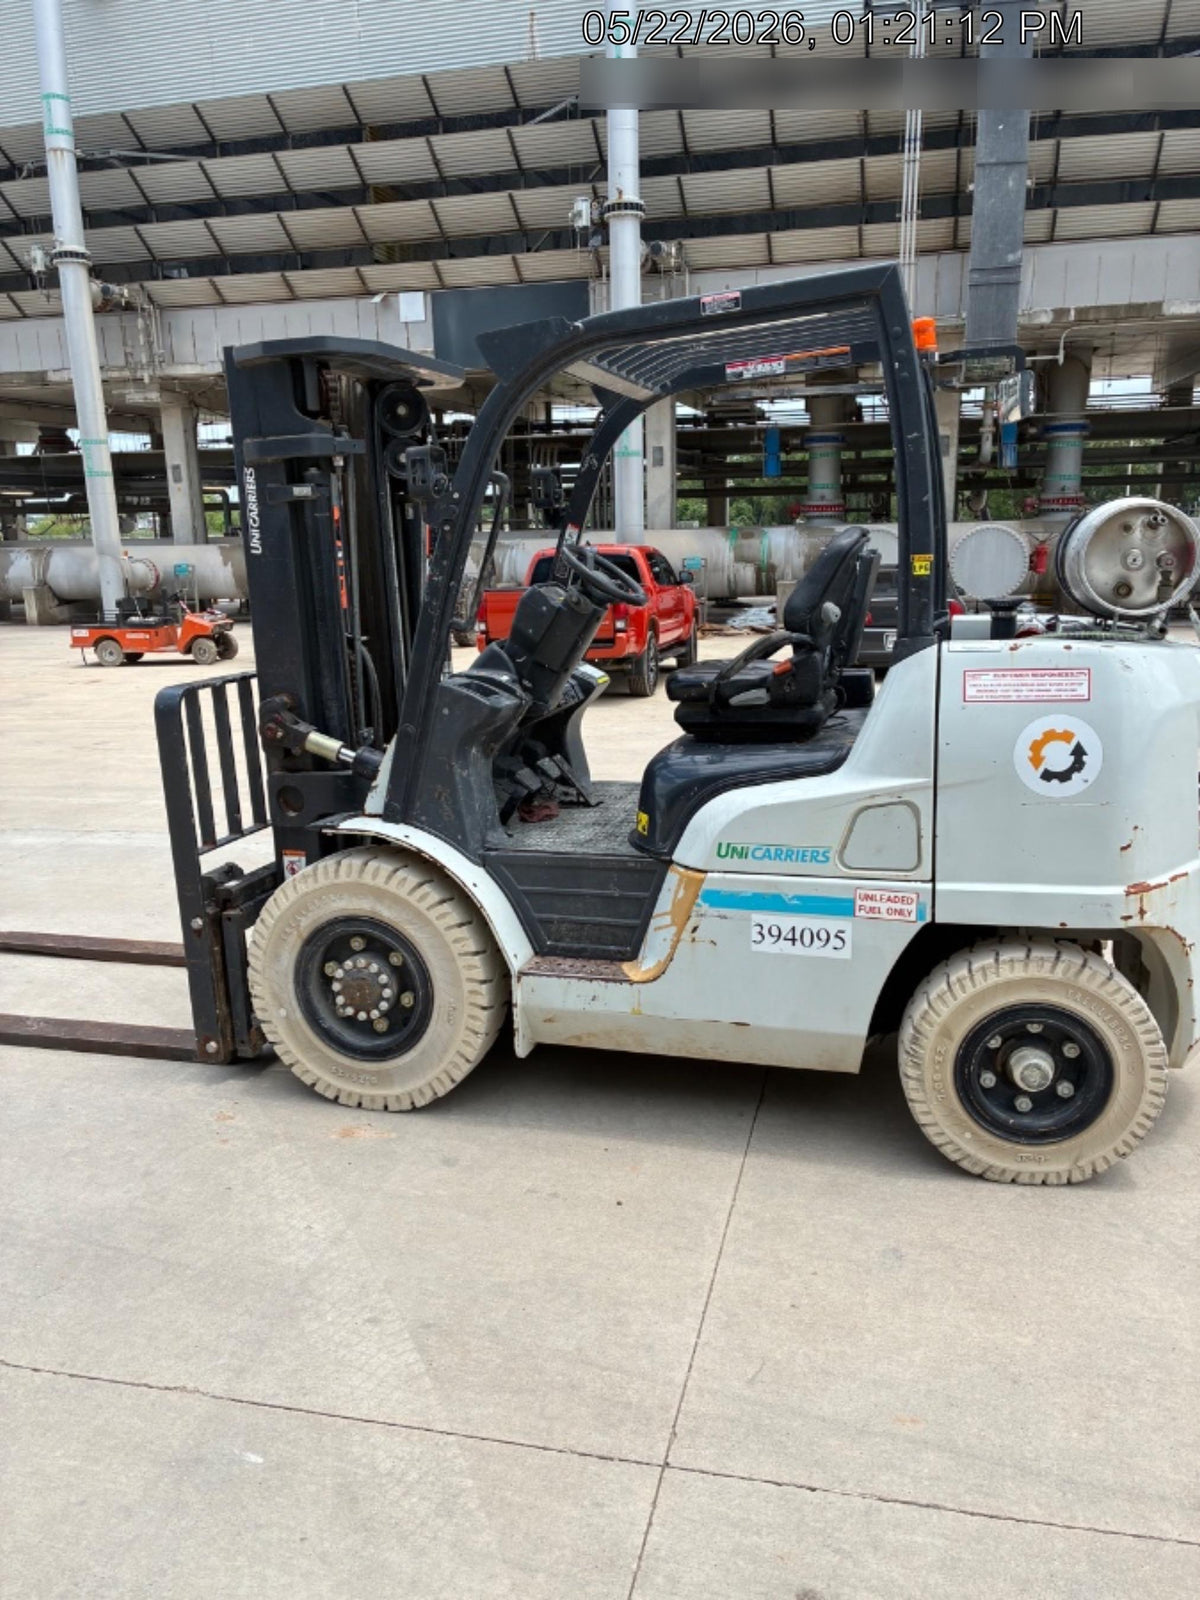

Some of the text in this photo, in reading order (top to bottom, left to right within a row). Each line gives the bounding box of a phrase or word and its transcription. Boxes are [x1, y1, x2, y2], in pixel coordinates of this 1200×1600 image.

[858, 892, 915, 905] UNLEADED
[858, 905, 913, 918] FUEL ONLY
[752, 923, 847, 951] 394095
